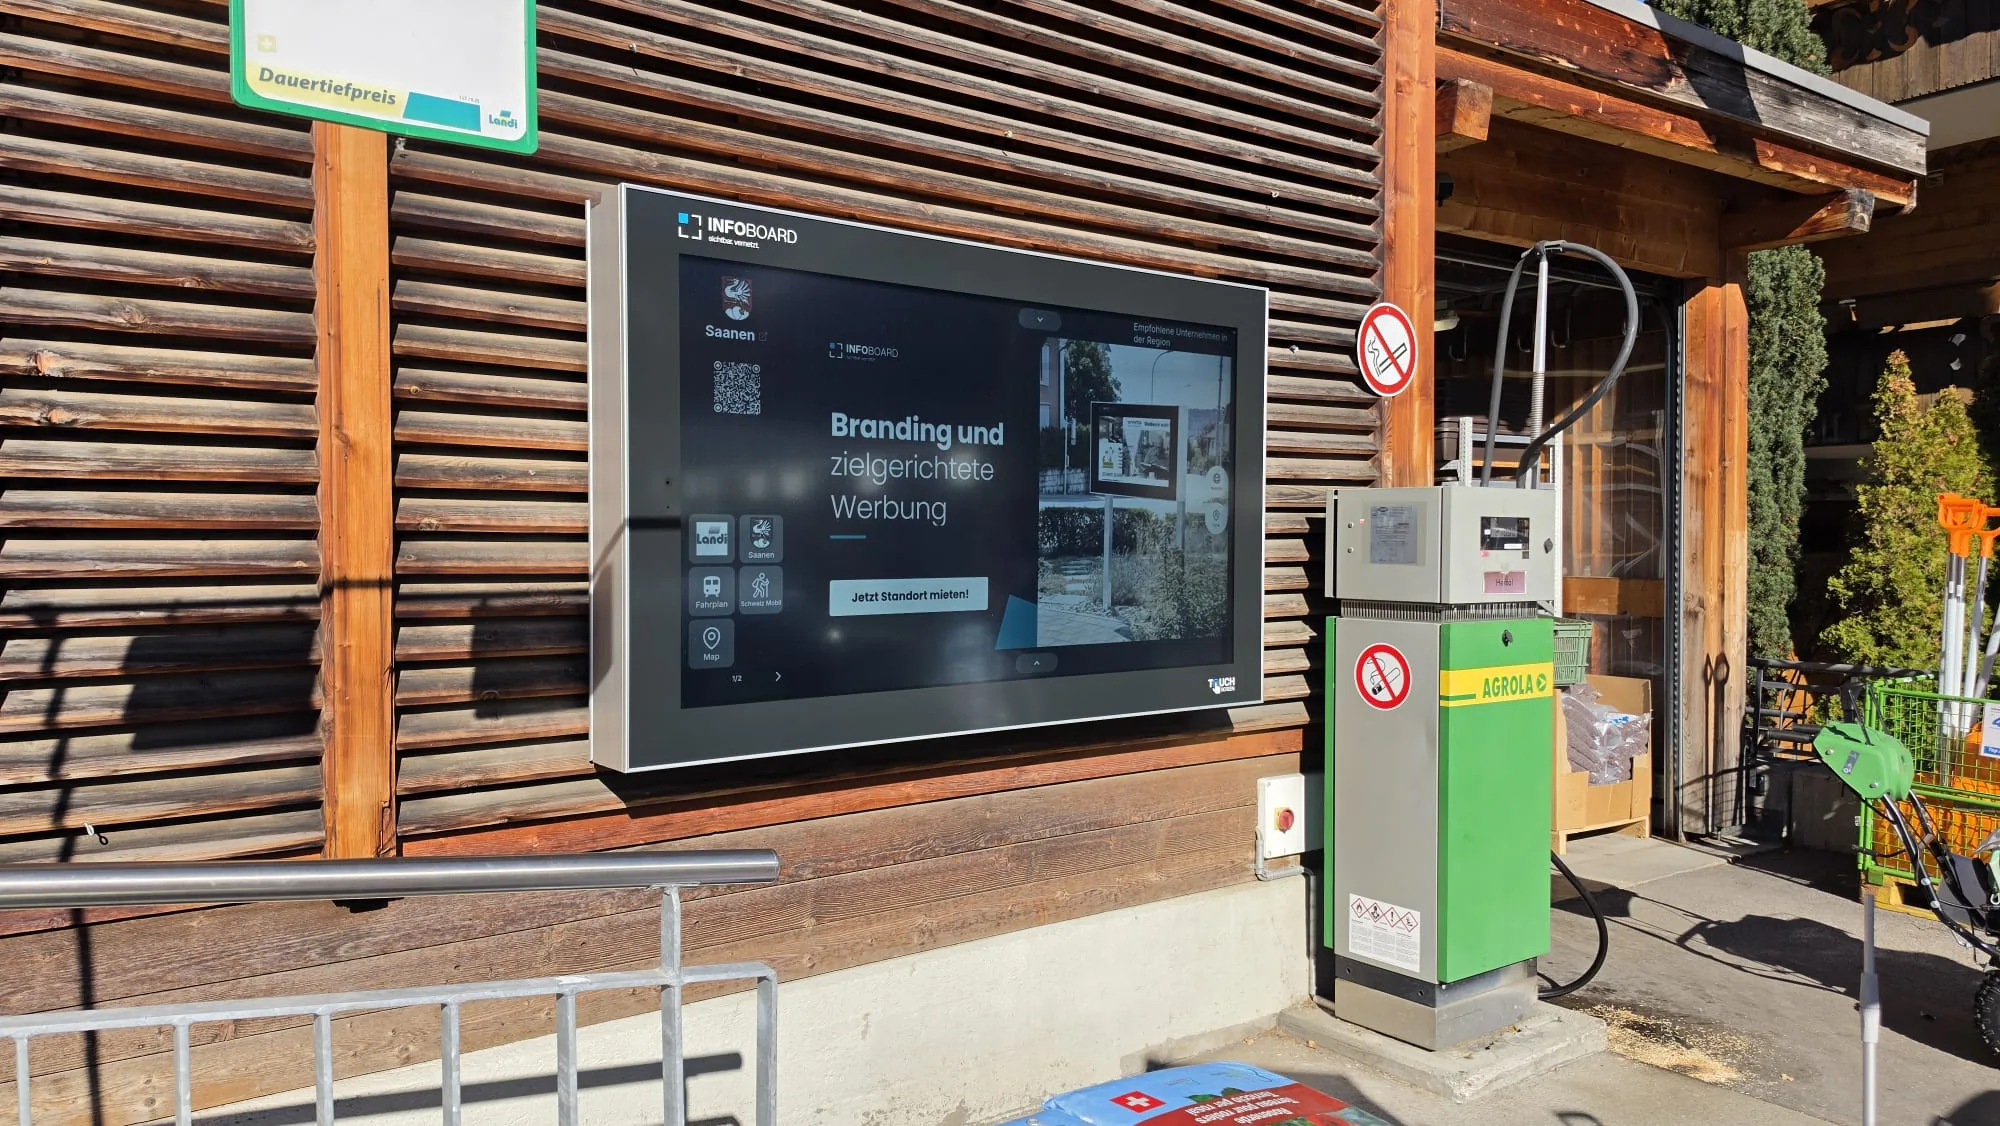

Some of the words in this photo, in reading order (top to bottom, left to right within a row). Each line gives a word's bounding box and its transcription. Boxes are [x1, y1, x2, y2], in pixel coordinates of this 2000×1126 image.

[258, 66, 396, 105] Dauertiefpreis
[488, 113, 518, 129] Landi
[708, 217, 797, 244] INFOBOARD
[705, 325, 755, 341] Saanen
[1133, 322, 1175, 337] Empfohlene
[1133, 335, 1145, 344] der
[1146, 336, 1171, 348] Region
[846, 343, 899, 358] INFOBOARD
[831, 411, 952, 450] Branding
[958, 422, 1004, 446] und
[830, 450, 995, 486] zielgerichtete
[830, 494, 947, 527] Werbung
[696, 534, 728, 545] Landi
[748, 551, 774, 560] Saanen
[852, 591, 879, 603] Jetzt
[881, 590, 928, 602] Standort
[929, 588, 969, 600] mieten!
[695, 601, 728, 610] Fahrplan
[703, 653, 720, 661] Map
[1482, 675, 1534, 699] AGROLA
